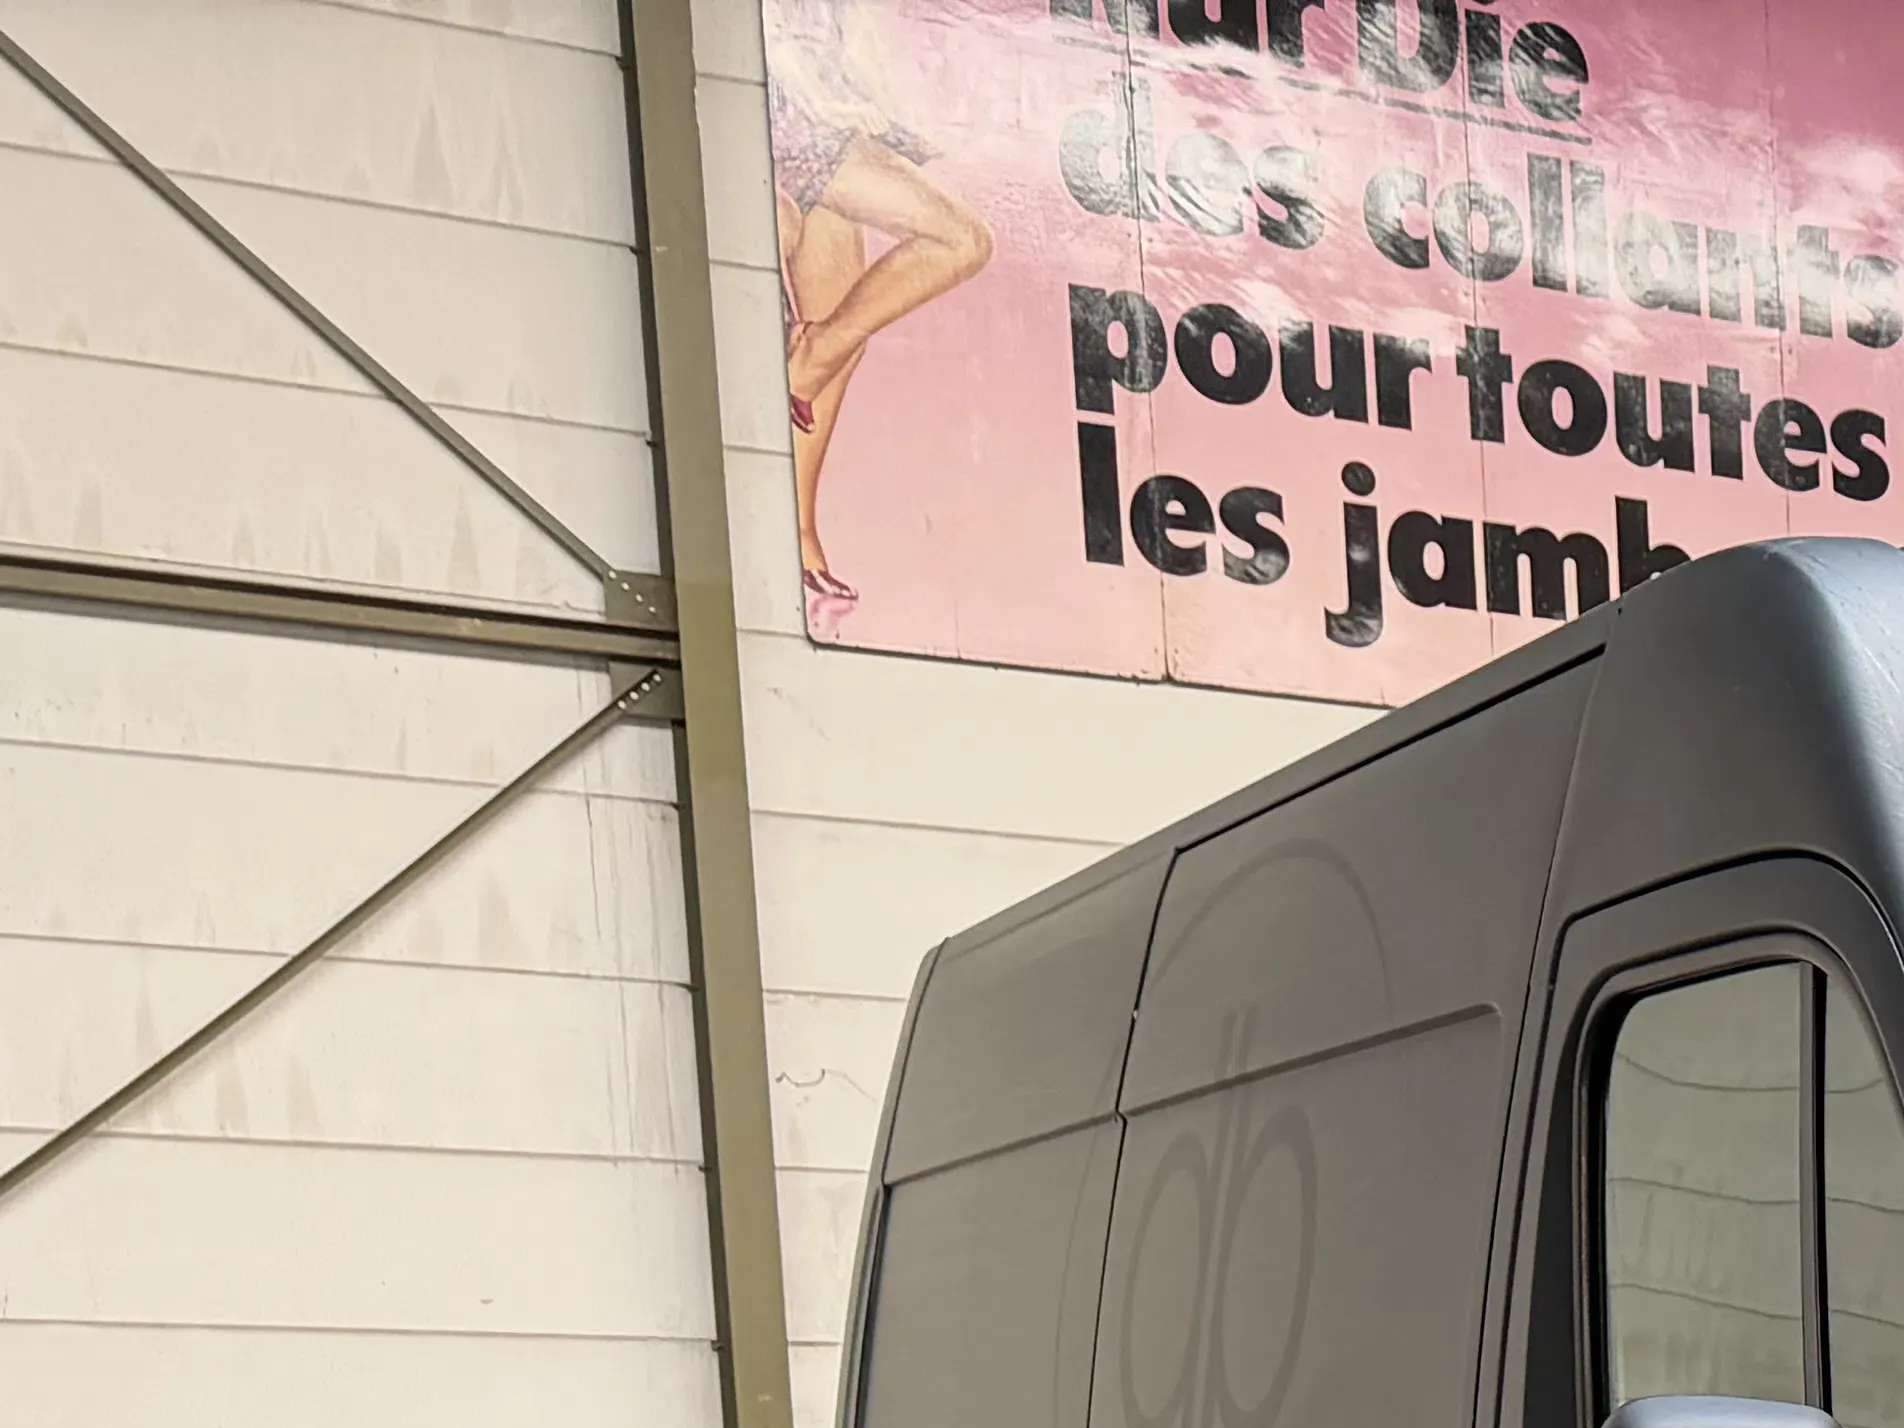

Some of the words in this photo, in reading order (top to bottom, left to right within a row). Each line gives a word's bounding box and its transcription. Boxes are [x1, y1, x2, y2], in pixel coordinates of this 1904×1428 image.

[1058, 69, 1325, 250] des
[1067, 282, 1433, 432] pour
[1456, 324, 1891, 502] toutes
[1076, 421, 1291, 586] les
